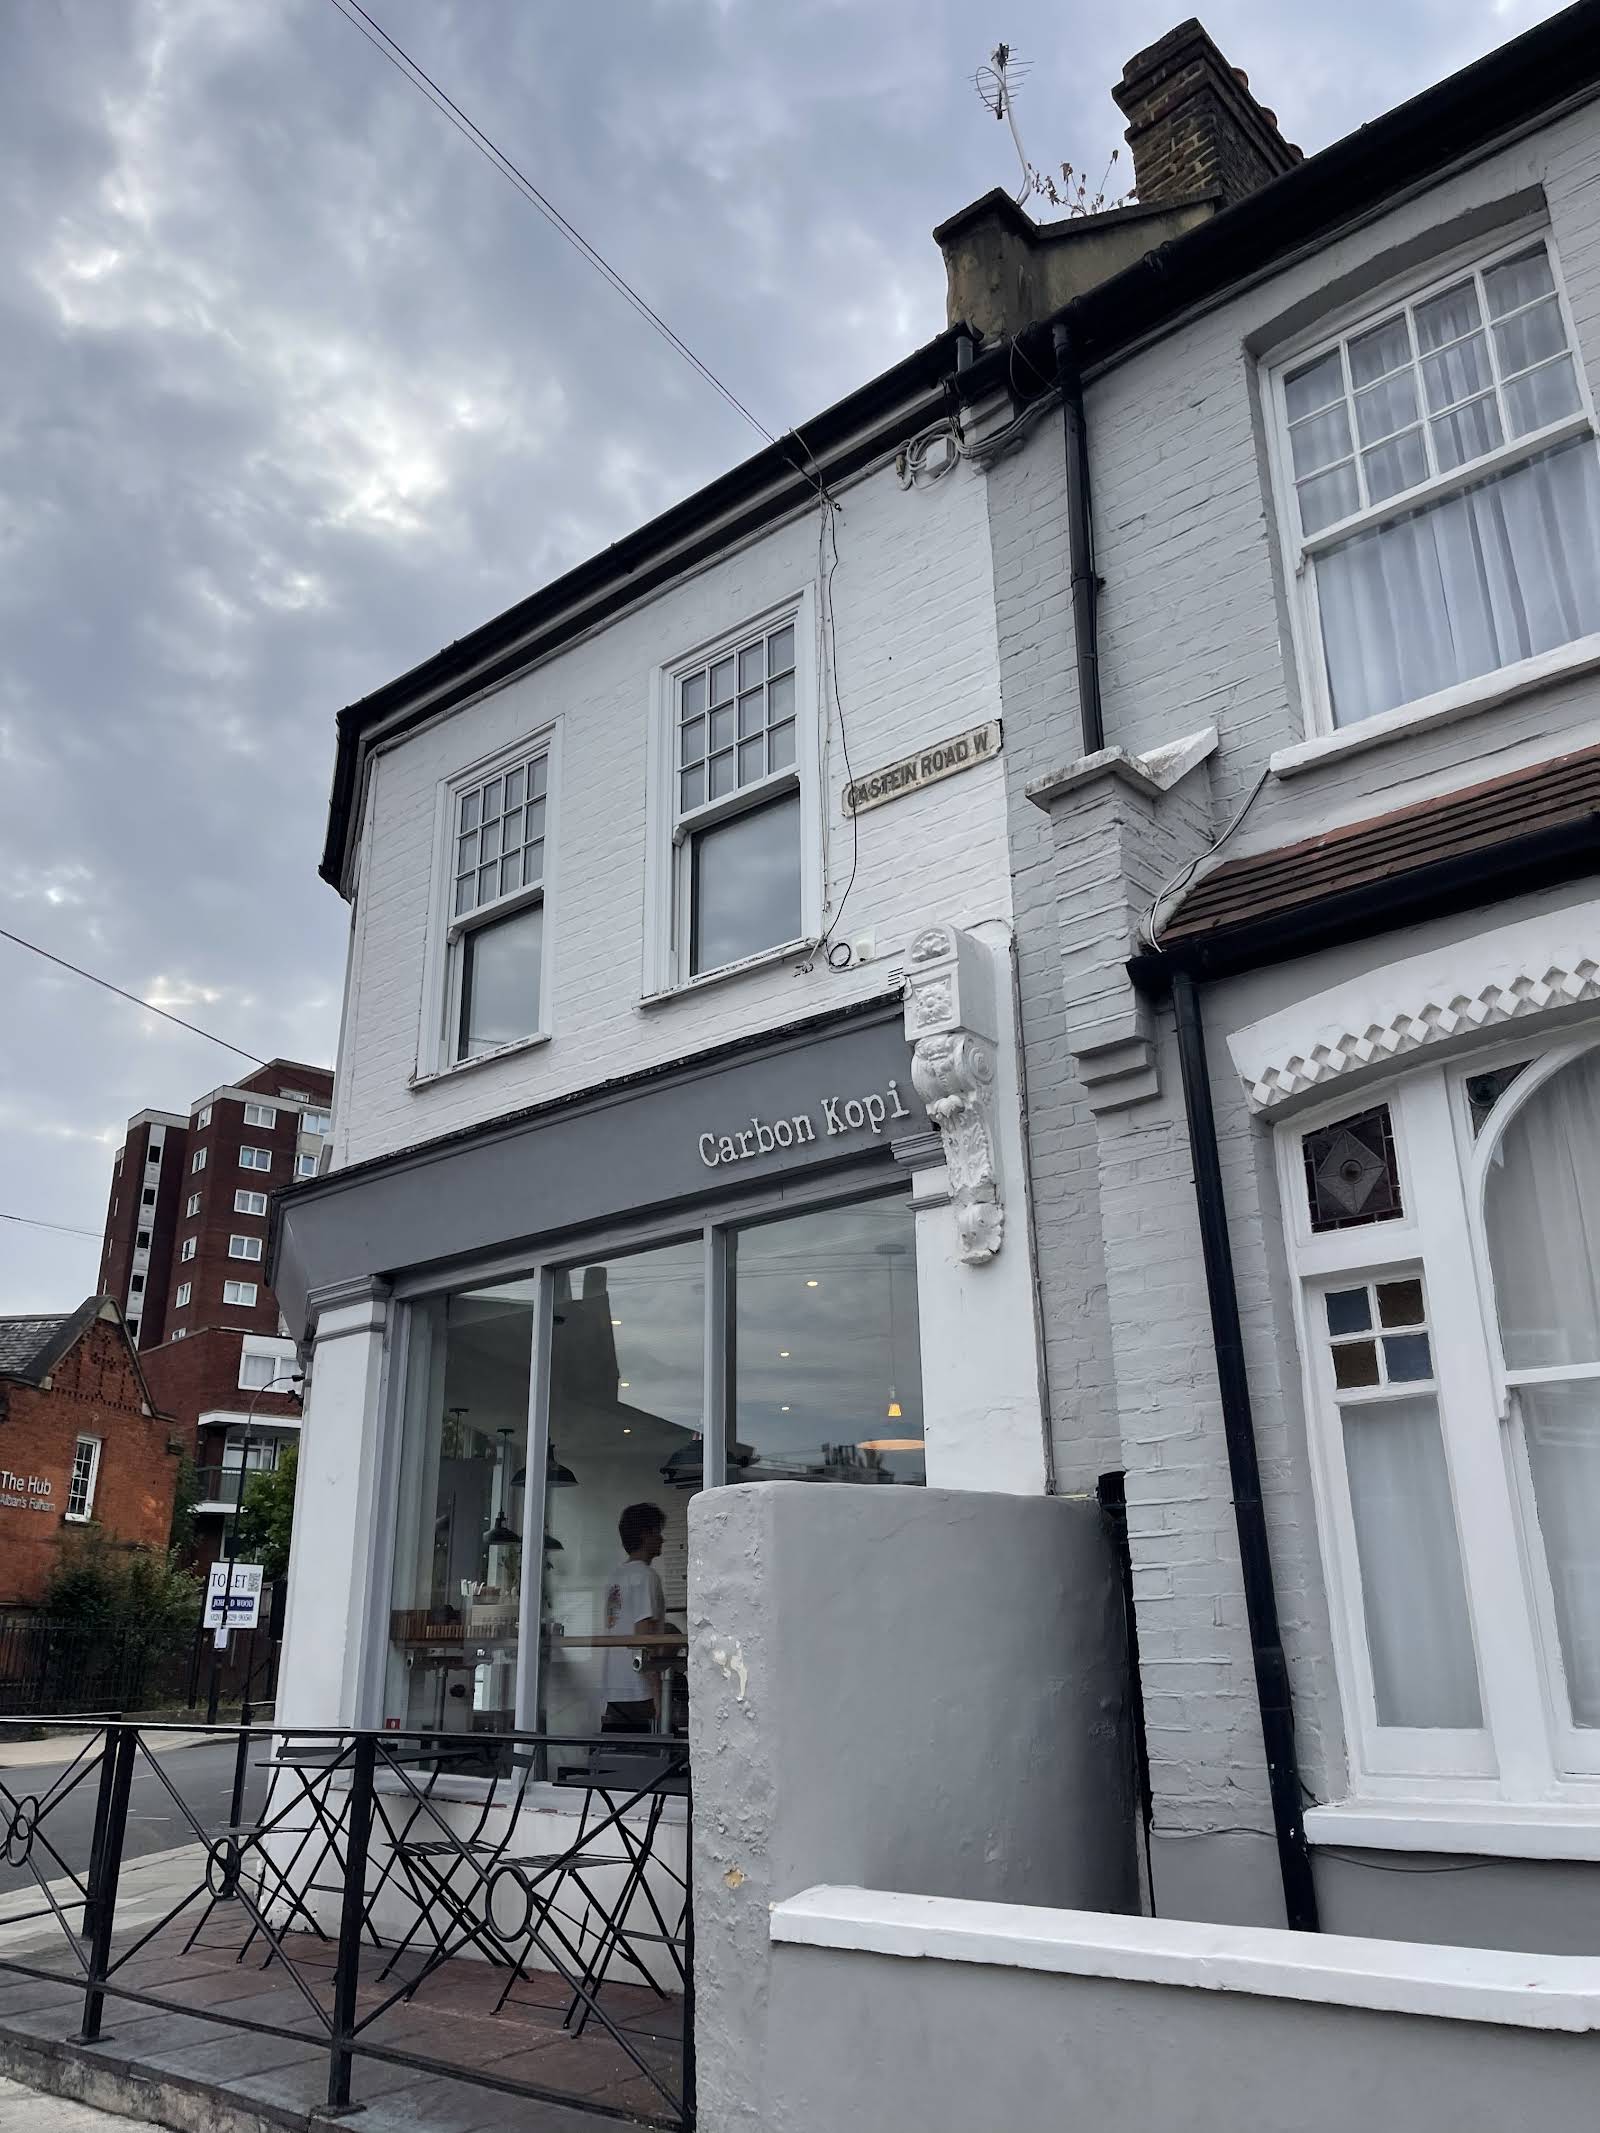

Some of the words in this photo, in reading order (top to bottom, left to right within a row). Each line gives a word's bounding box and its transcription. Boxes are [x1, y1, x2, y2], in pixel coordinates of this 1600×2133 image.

[920, 740, 968, 777] ROAD
[698, 1117, 816, 1167] Carbon
[820, 1080, 910, 1134] Kopi
[1, 1471, 25, 1492] The
[27, 1475, 52, 1496] Hub
[212, 1573, 226, 1588] TO
[230, 1574, 248, 1589] ET
[236, 1599, 253, 1608] WOOD
